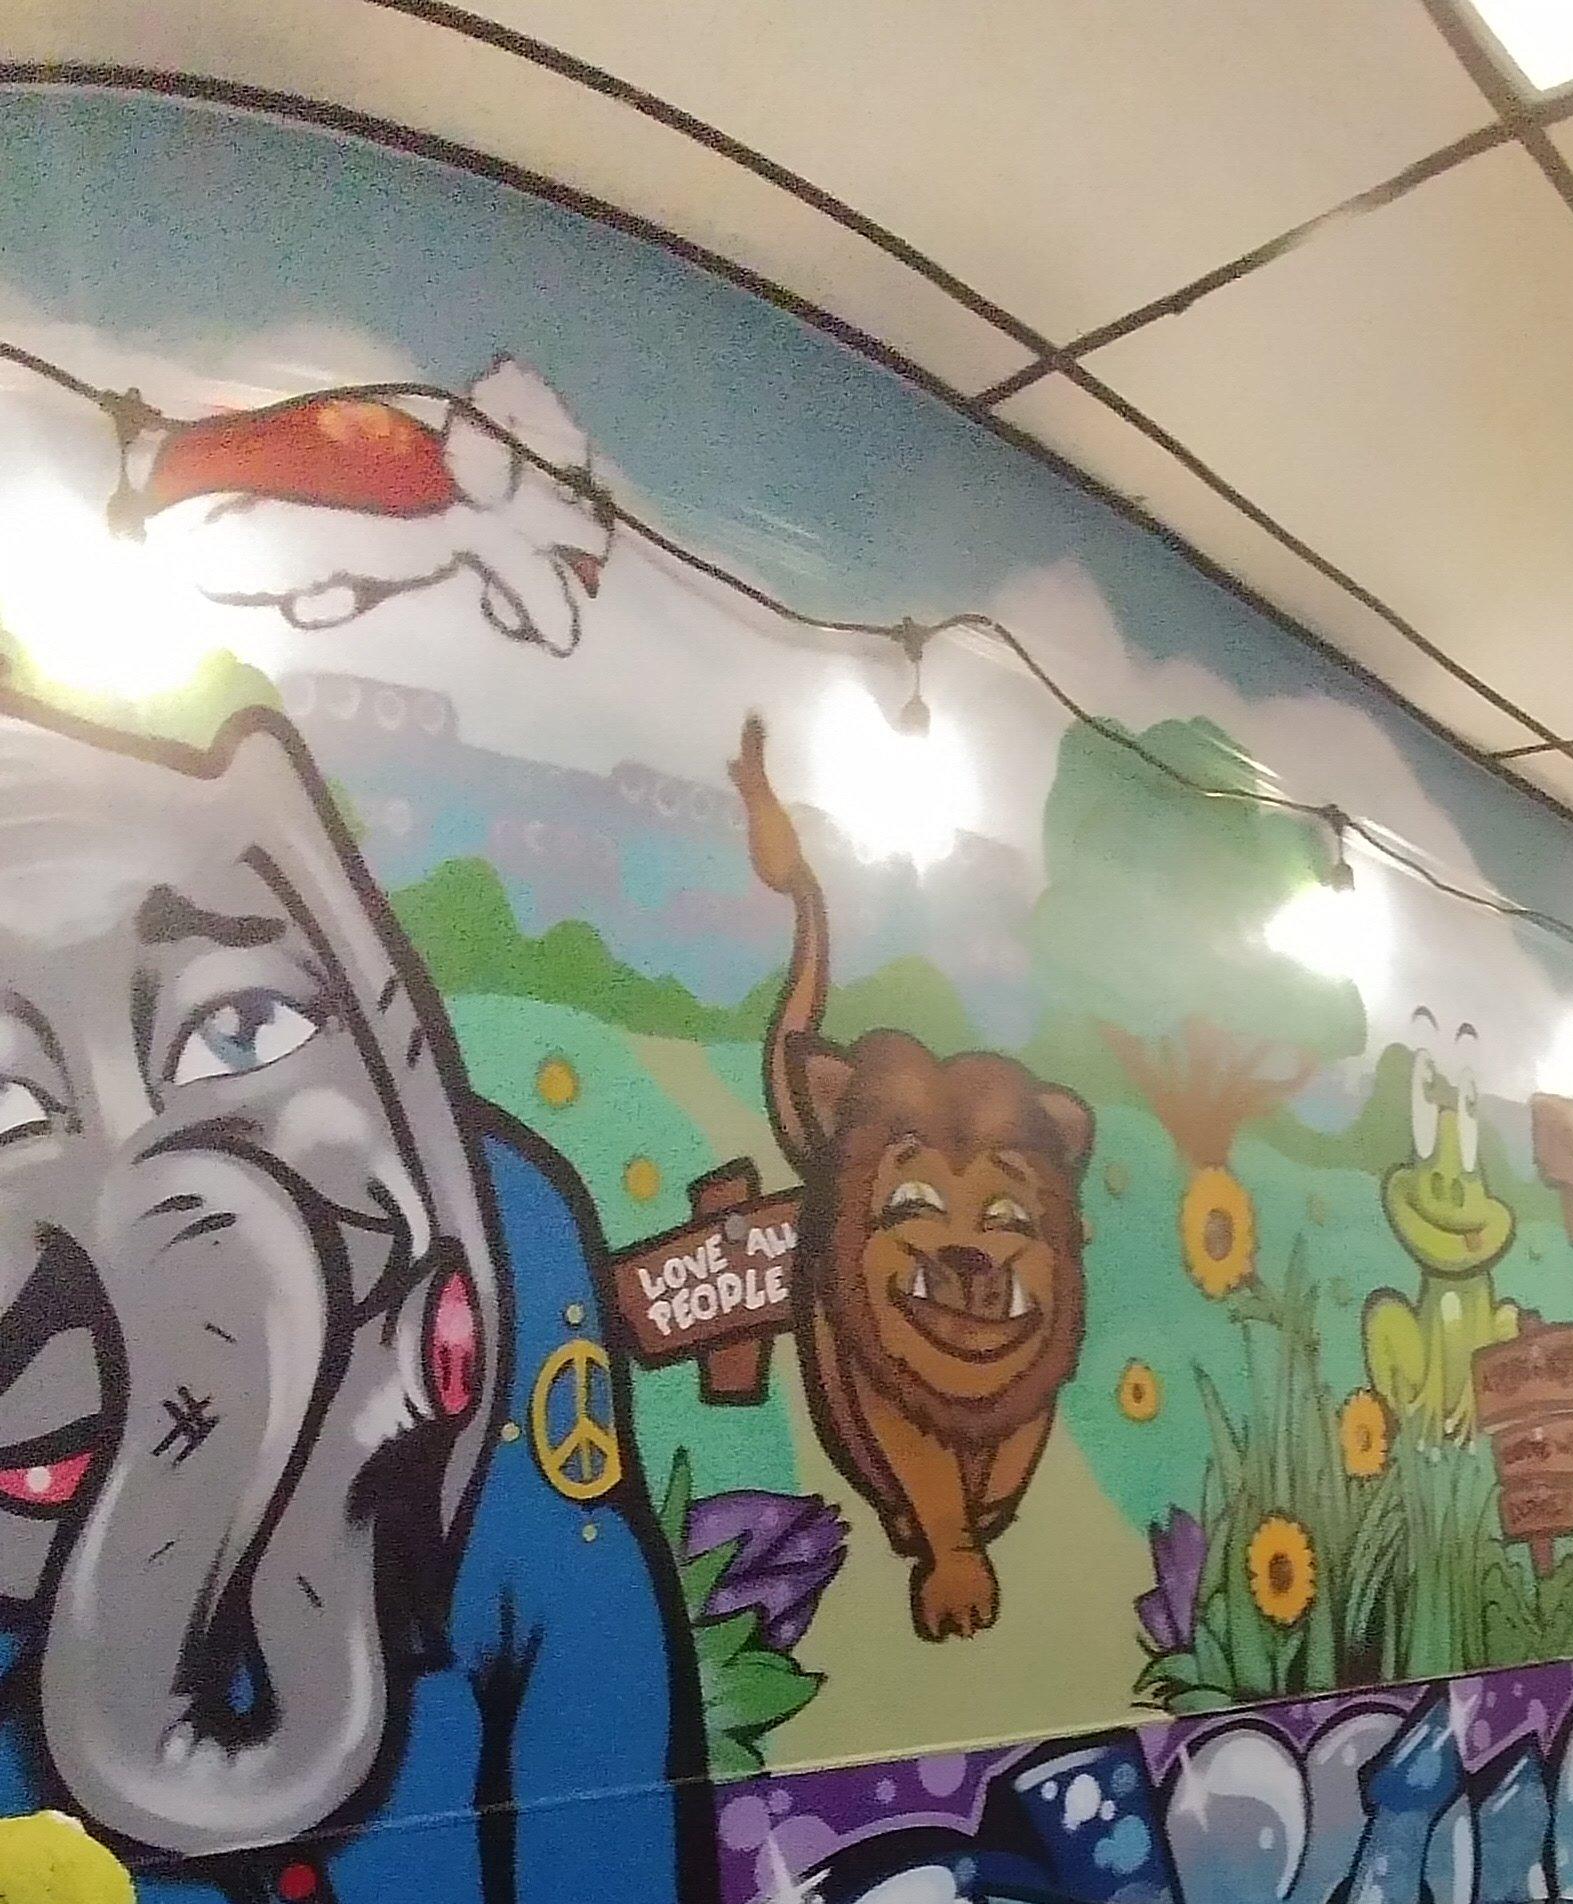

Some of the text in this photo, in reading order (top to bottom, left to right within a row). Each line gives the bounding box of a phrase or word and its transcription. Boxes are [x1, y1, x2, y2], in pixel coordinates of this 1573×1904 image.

[638, 1222, 798, 1299] LOVE ALL
[648, 1266, 790, 1335] PEOPLE
